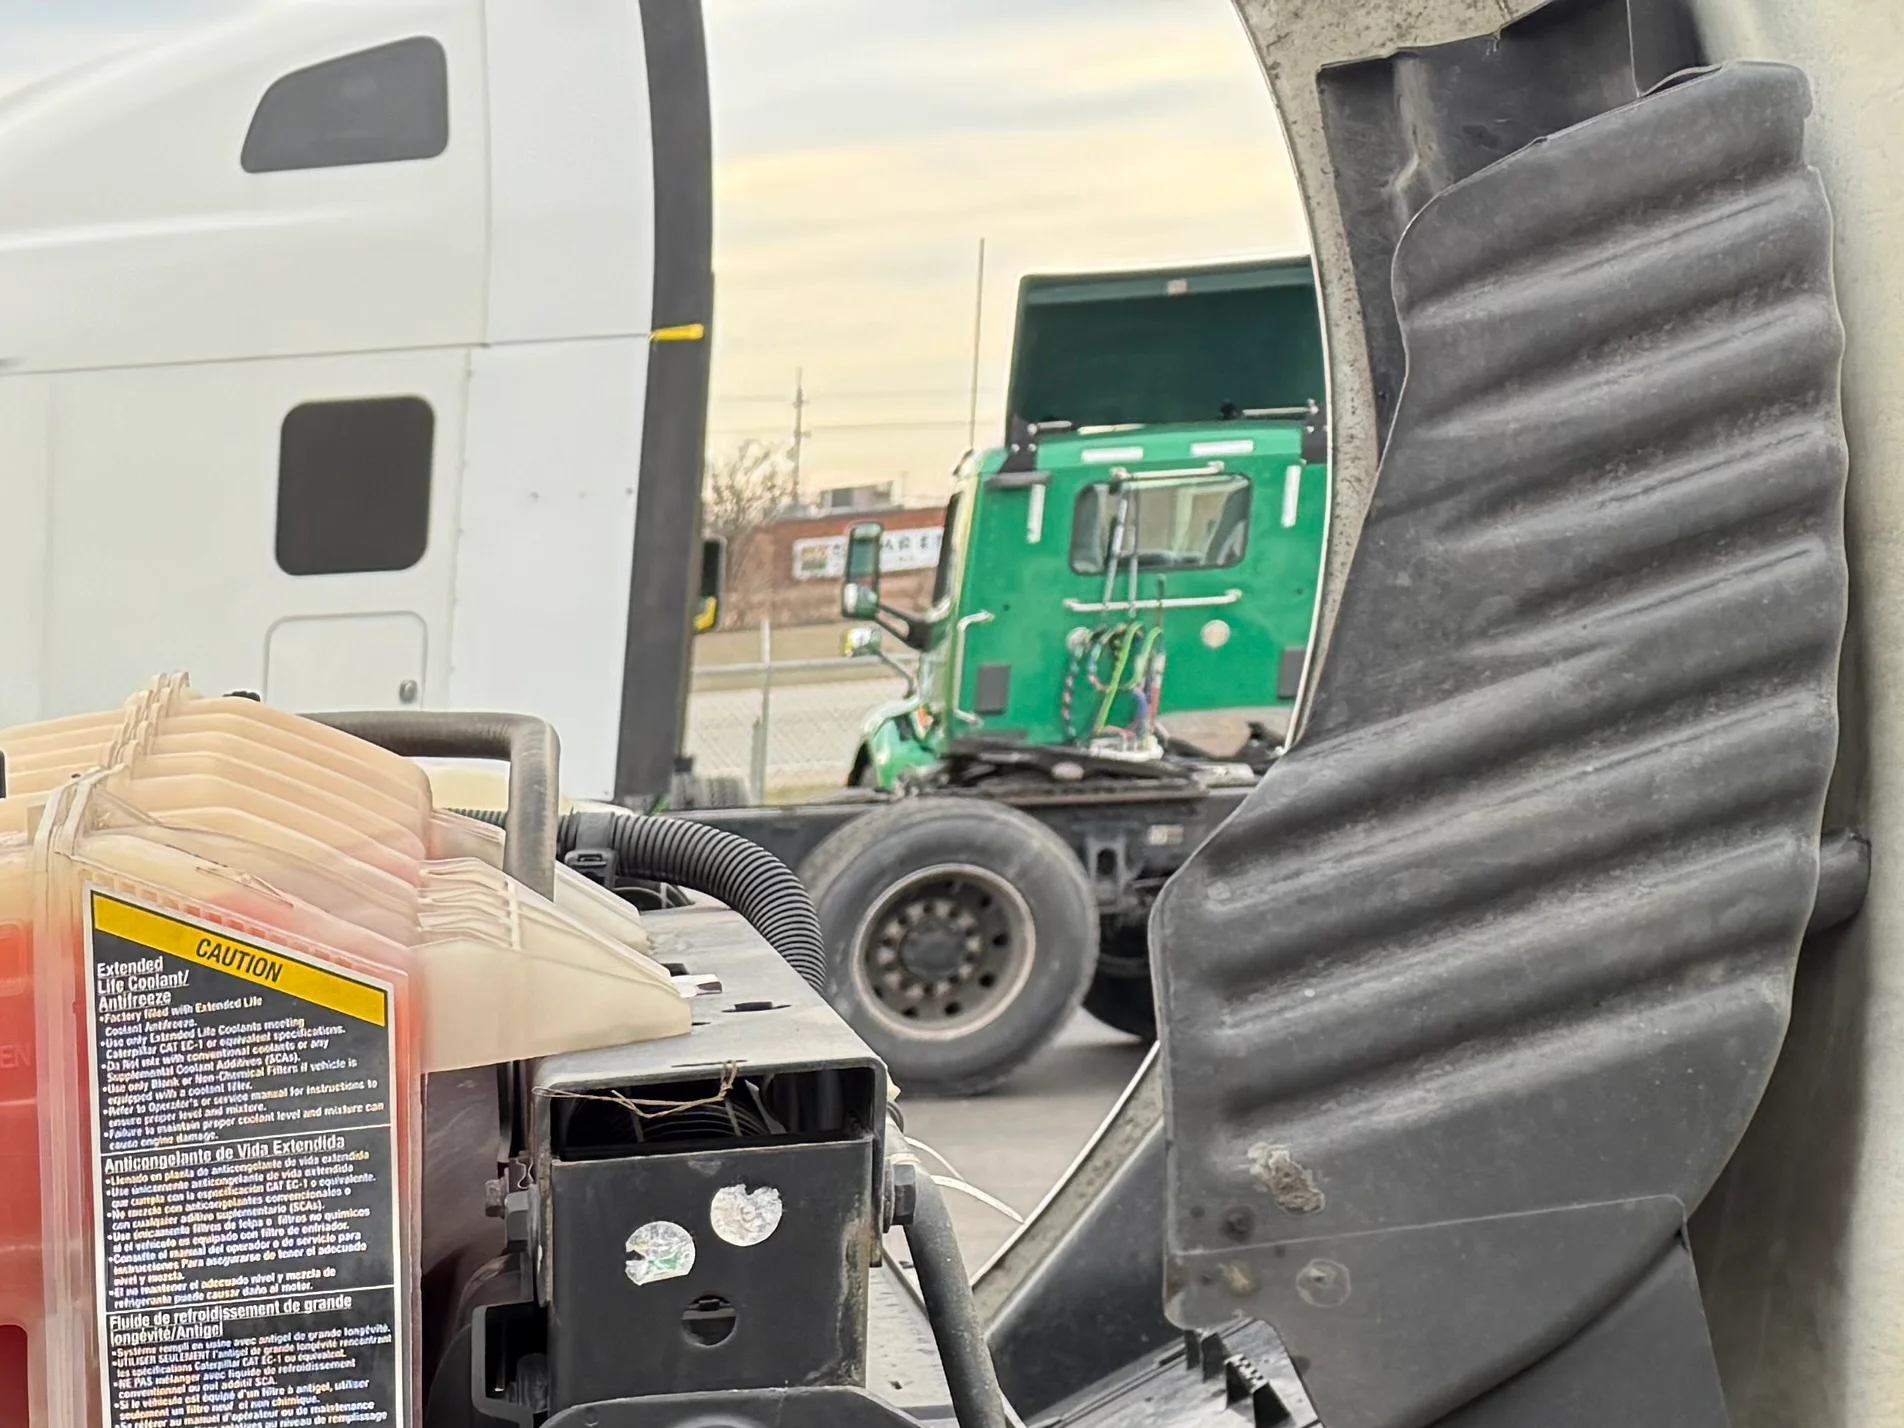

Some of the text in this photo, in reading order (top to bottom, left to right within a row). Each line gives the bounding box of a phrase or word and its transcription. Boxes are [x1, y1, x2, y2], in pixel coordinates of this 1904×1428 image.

[97, 956, 164, 978] Extended
[195, 937, 284, 982] CAUTION
[98, 969, 189, 993] Life Coolant/
[98, 990, 172, 1011] Antifreeze
[105, 1136, 345, 1173] Anticongelante de Vida Extendida
[111, 1296, 352, 1329] Fluide de refroidissement de grande
[111, 1323, 223, 1346] longévité/Antigel
